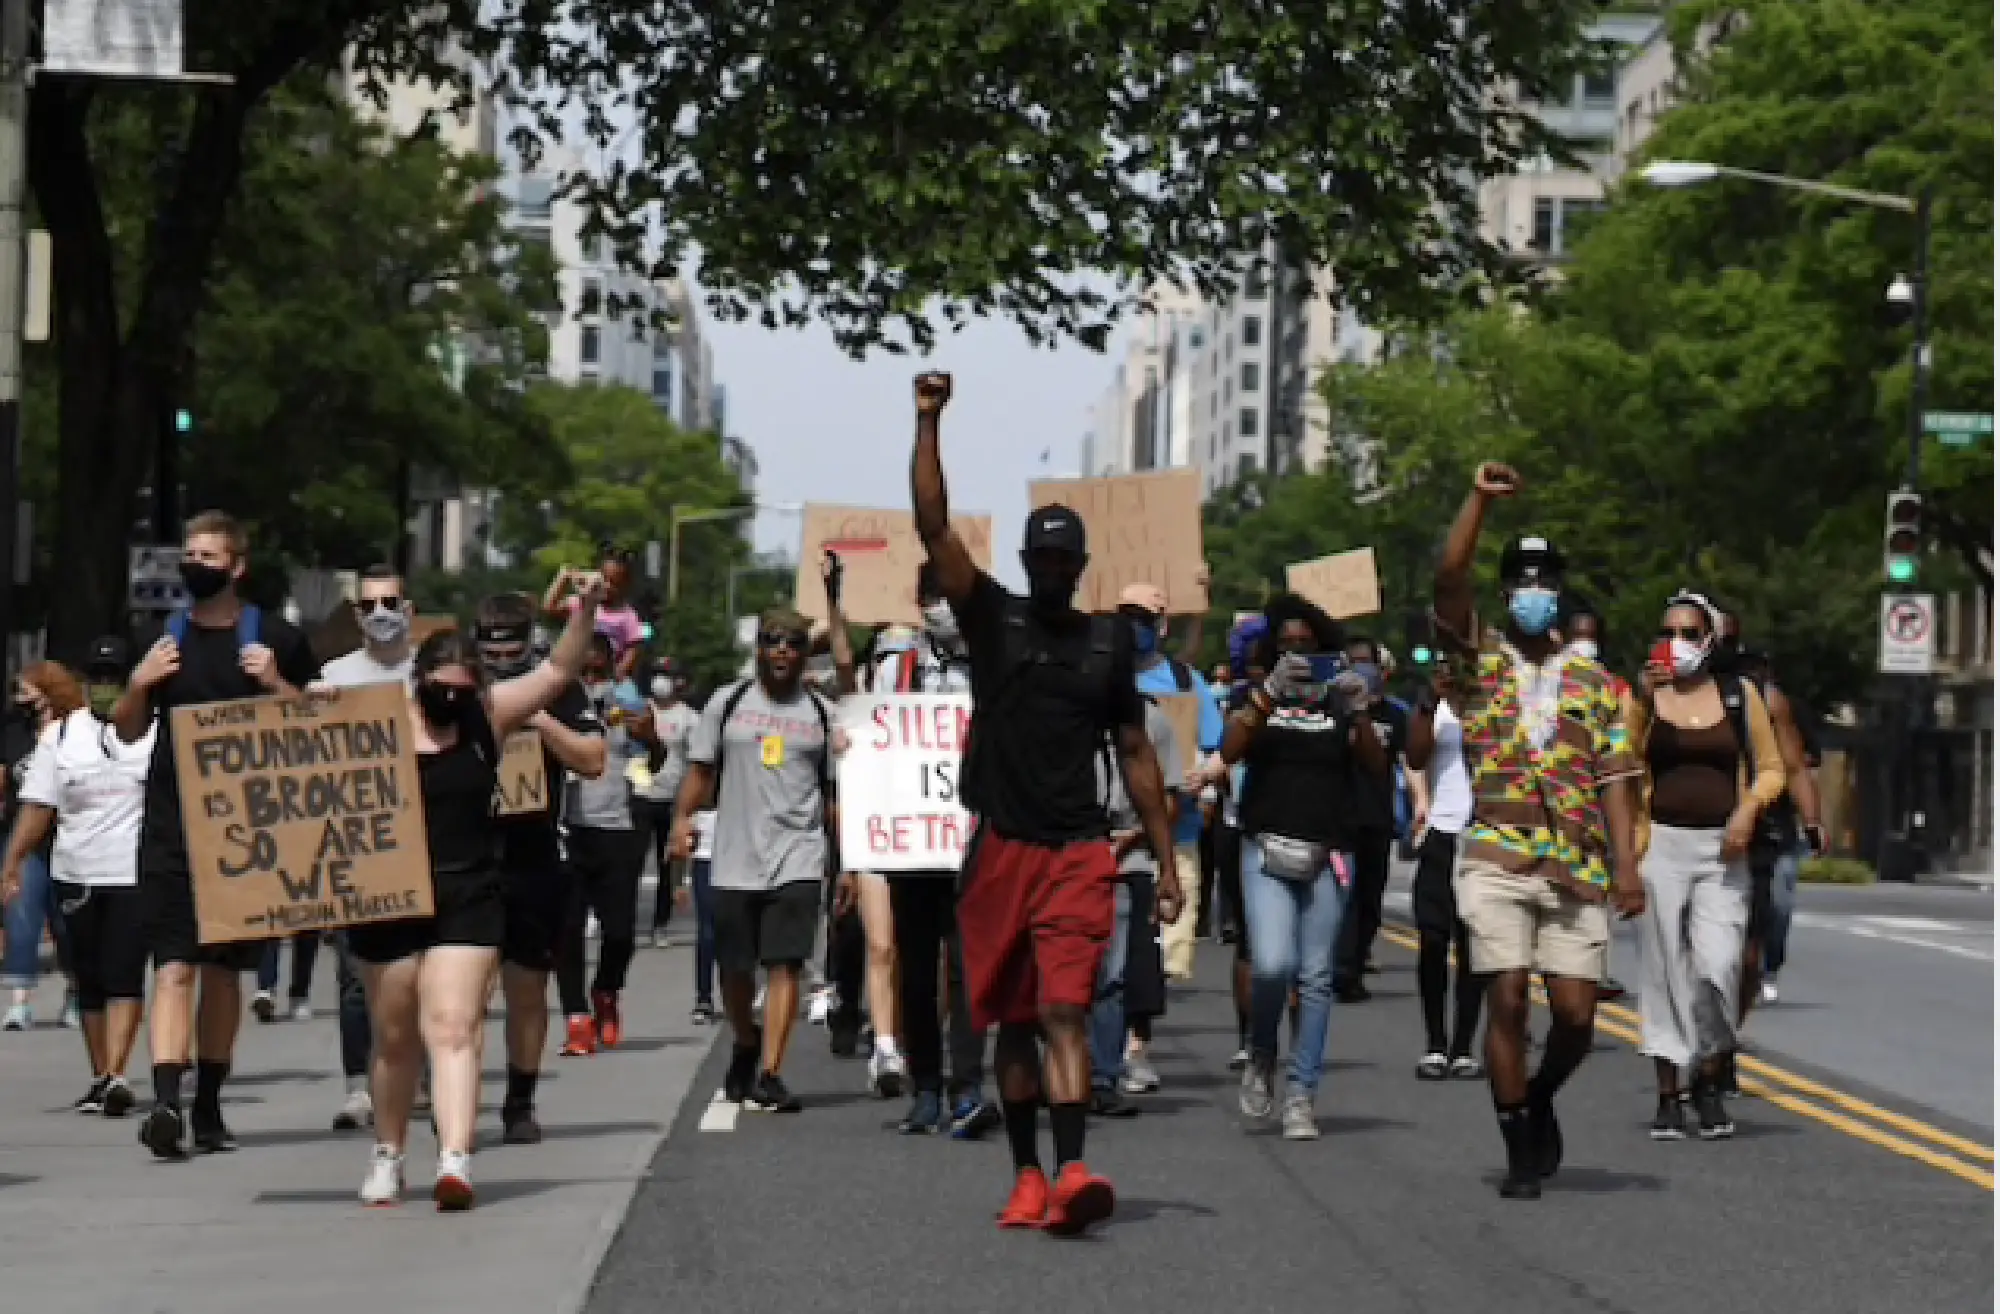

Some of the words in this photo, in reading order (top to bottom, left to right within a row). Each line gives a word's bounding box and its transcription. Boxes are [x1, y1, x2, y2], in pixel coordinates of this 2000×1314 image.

[192, 716, 399, 777] FOUNDATION
[920, 760, 955, 802] IS
[203, 788, 234, 818] IS
[217, 823, 278, 878] SO
[316, 813, 398, 860] ARE
[276, 860, 353, 902] WE
